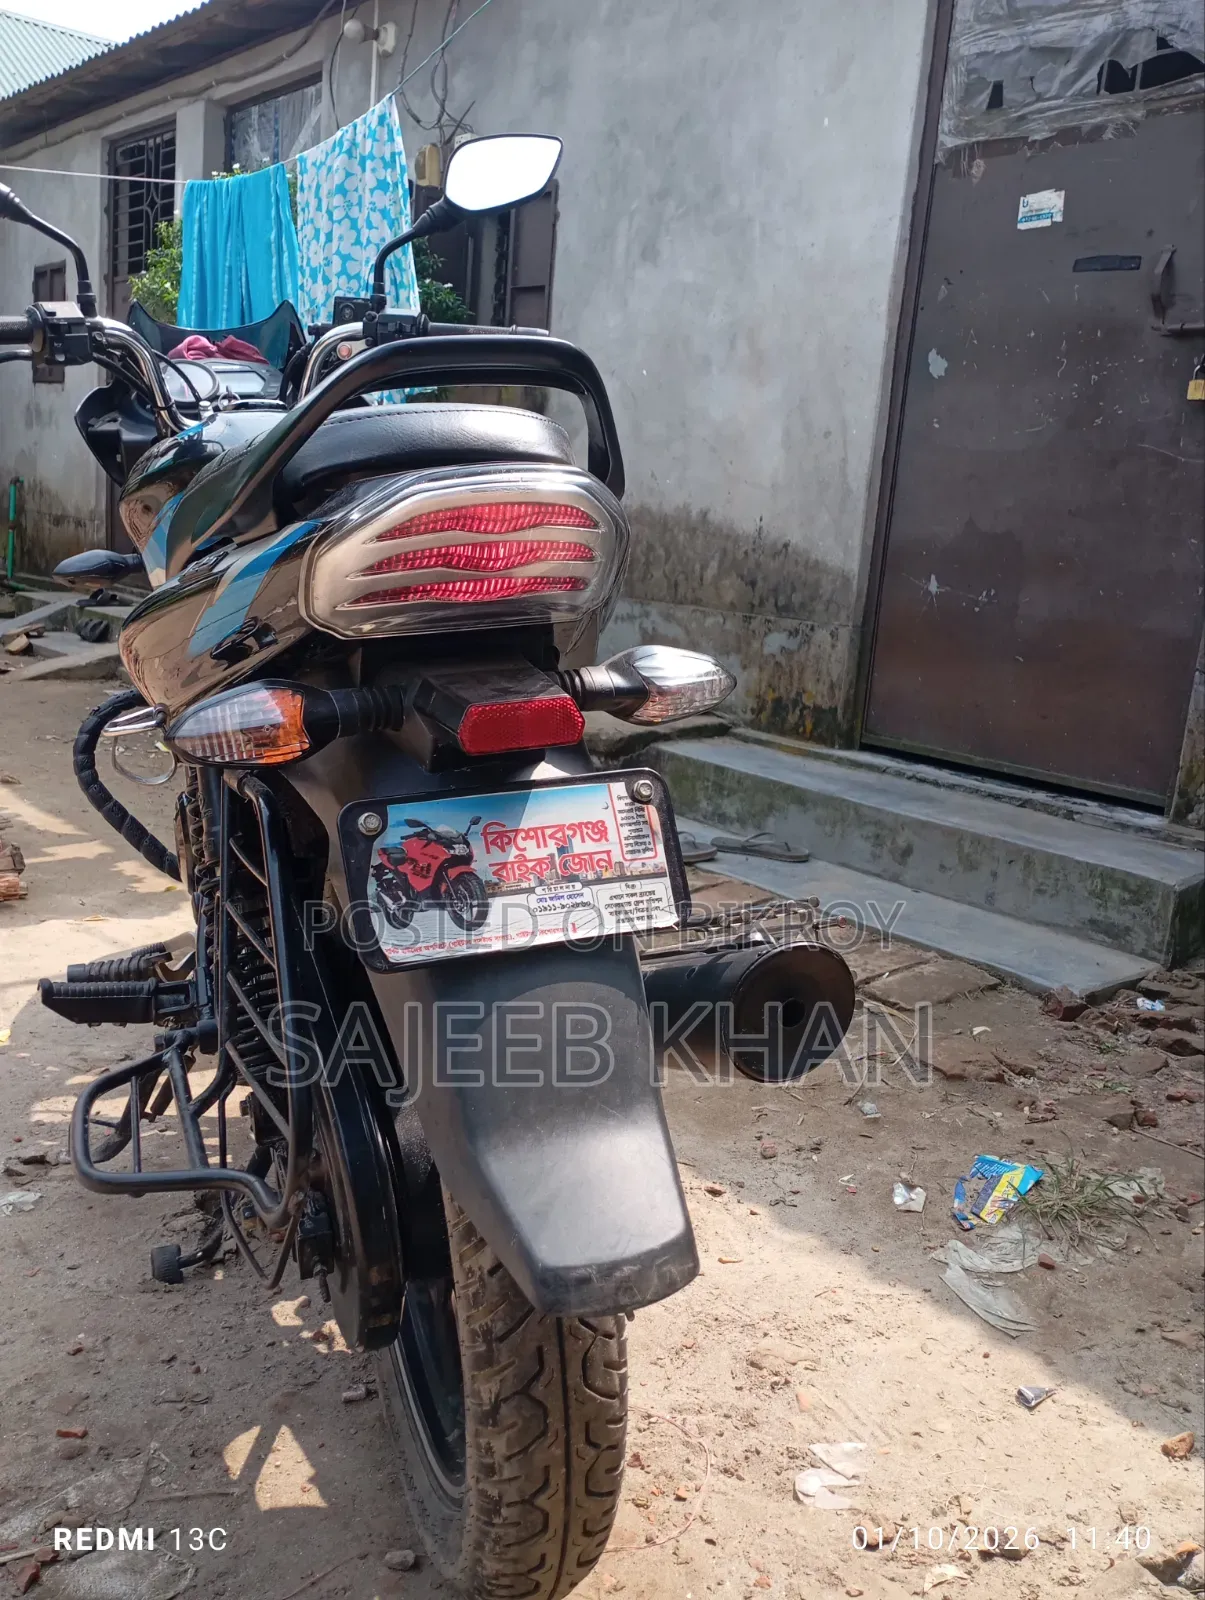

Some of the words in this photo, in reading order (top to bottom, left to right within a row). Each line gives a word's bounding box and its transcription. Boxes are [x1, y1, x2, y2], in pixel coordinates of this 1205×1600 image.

[480, 819, 610, 855] কিশোরগঞ্জ
[488, 853, 551, 883] বাইক
[557, 849, 614, 877] জোন
